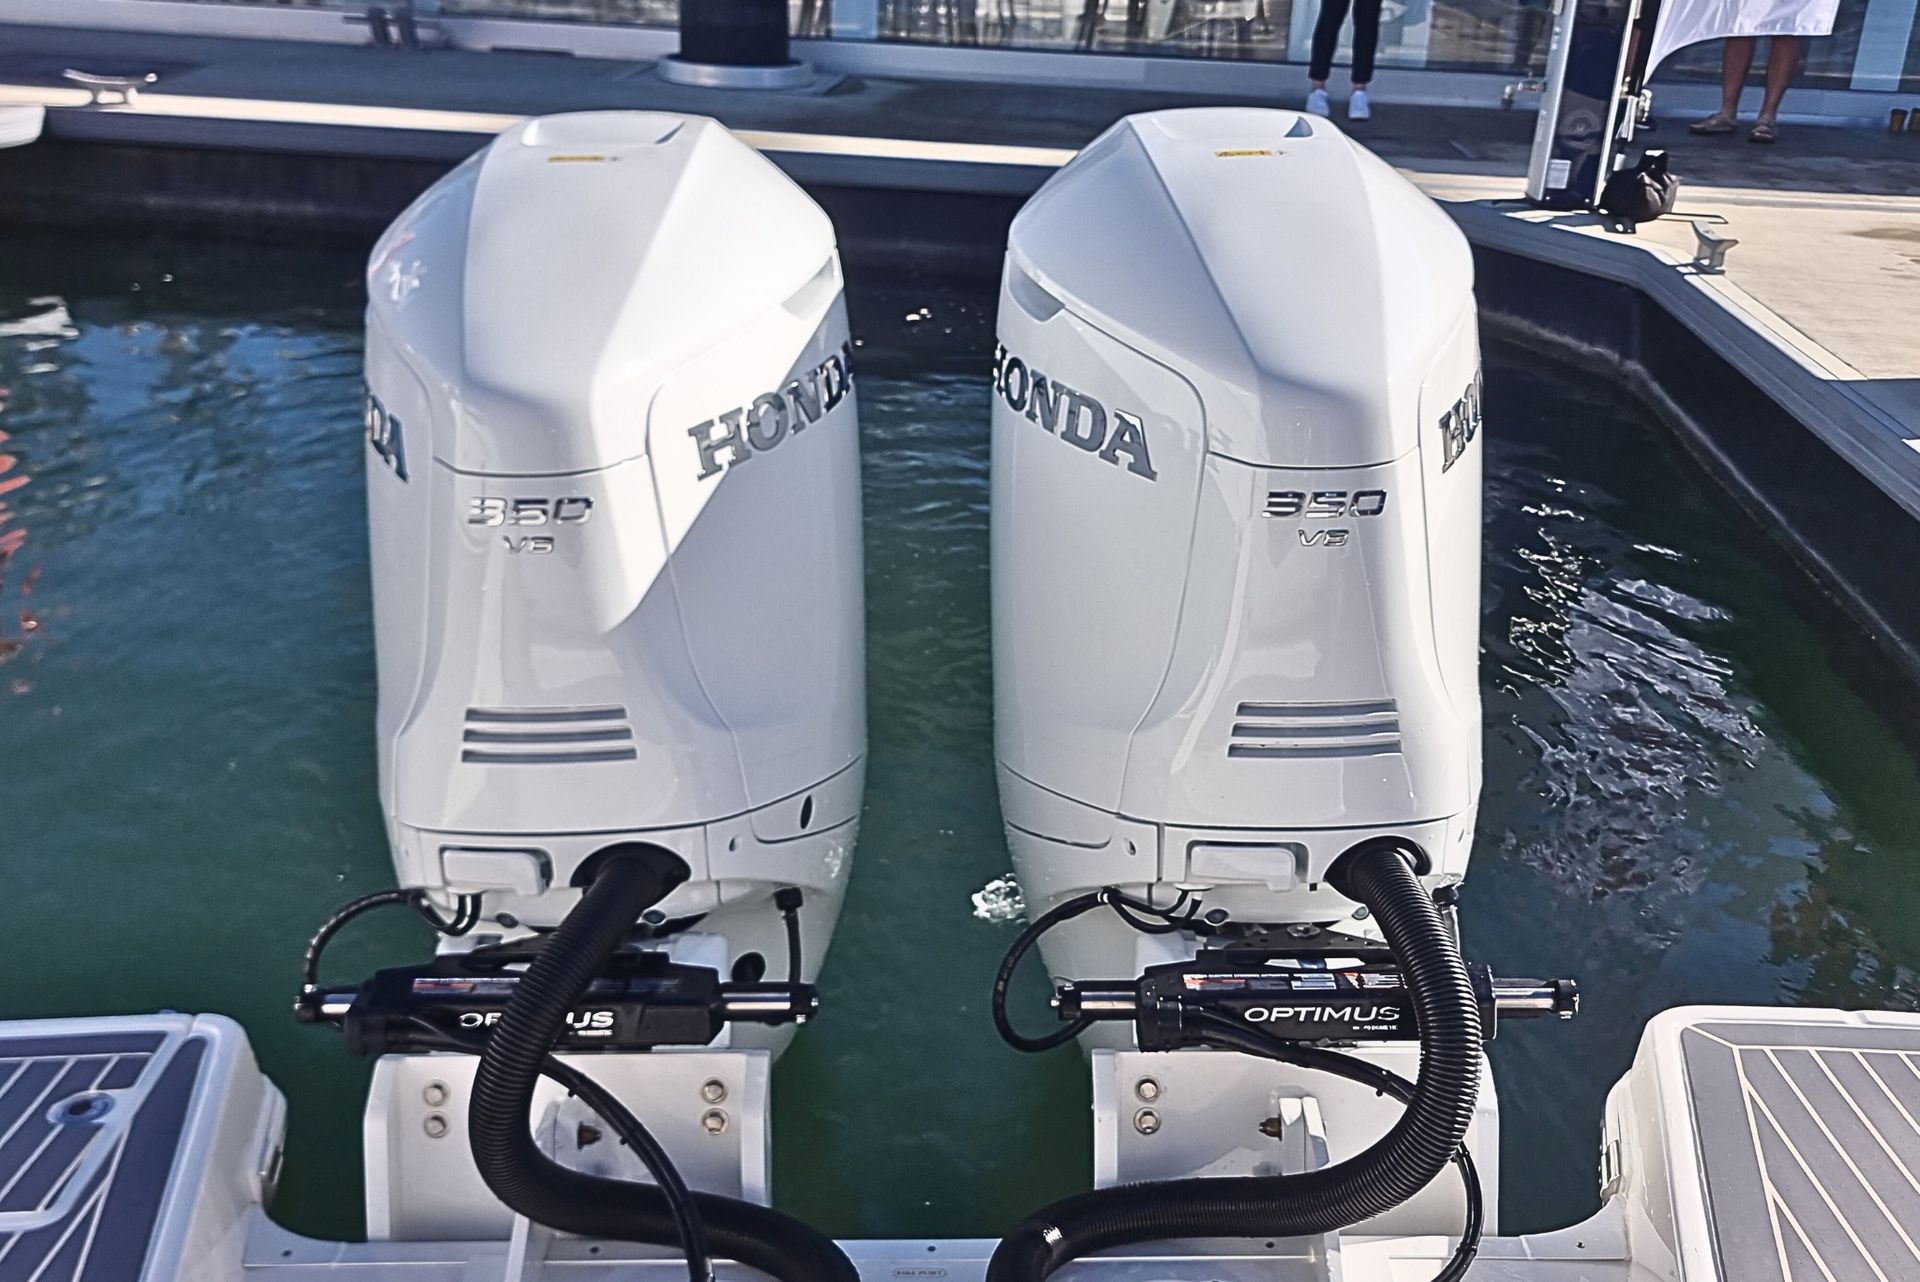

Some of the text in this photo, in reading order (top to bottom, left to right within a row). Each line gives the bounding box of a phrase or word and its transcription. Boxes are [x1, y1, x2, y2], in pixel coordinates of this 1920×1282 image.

[467, 496, 594, 527] 350
[1261, 489, 1388, 519] 350
[1297, 529, 1350, 547] V8
[1244, 1006, 1401, 1023] OPTIMUS
